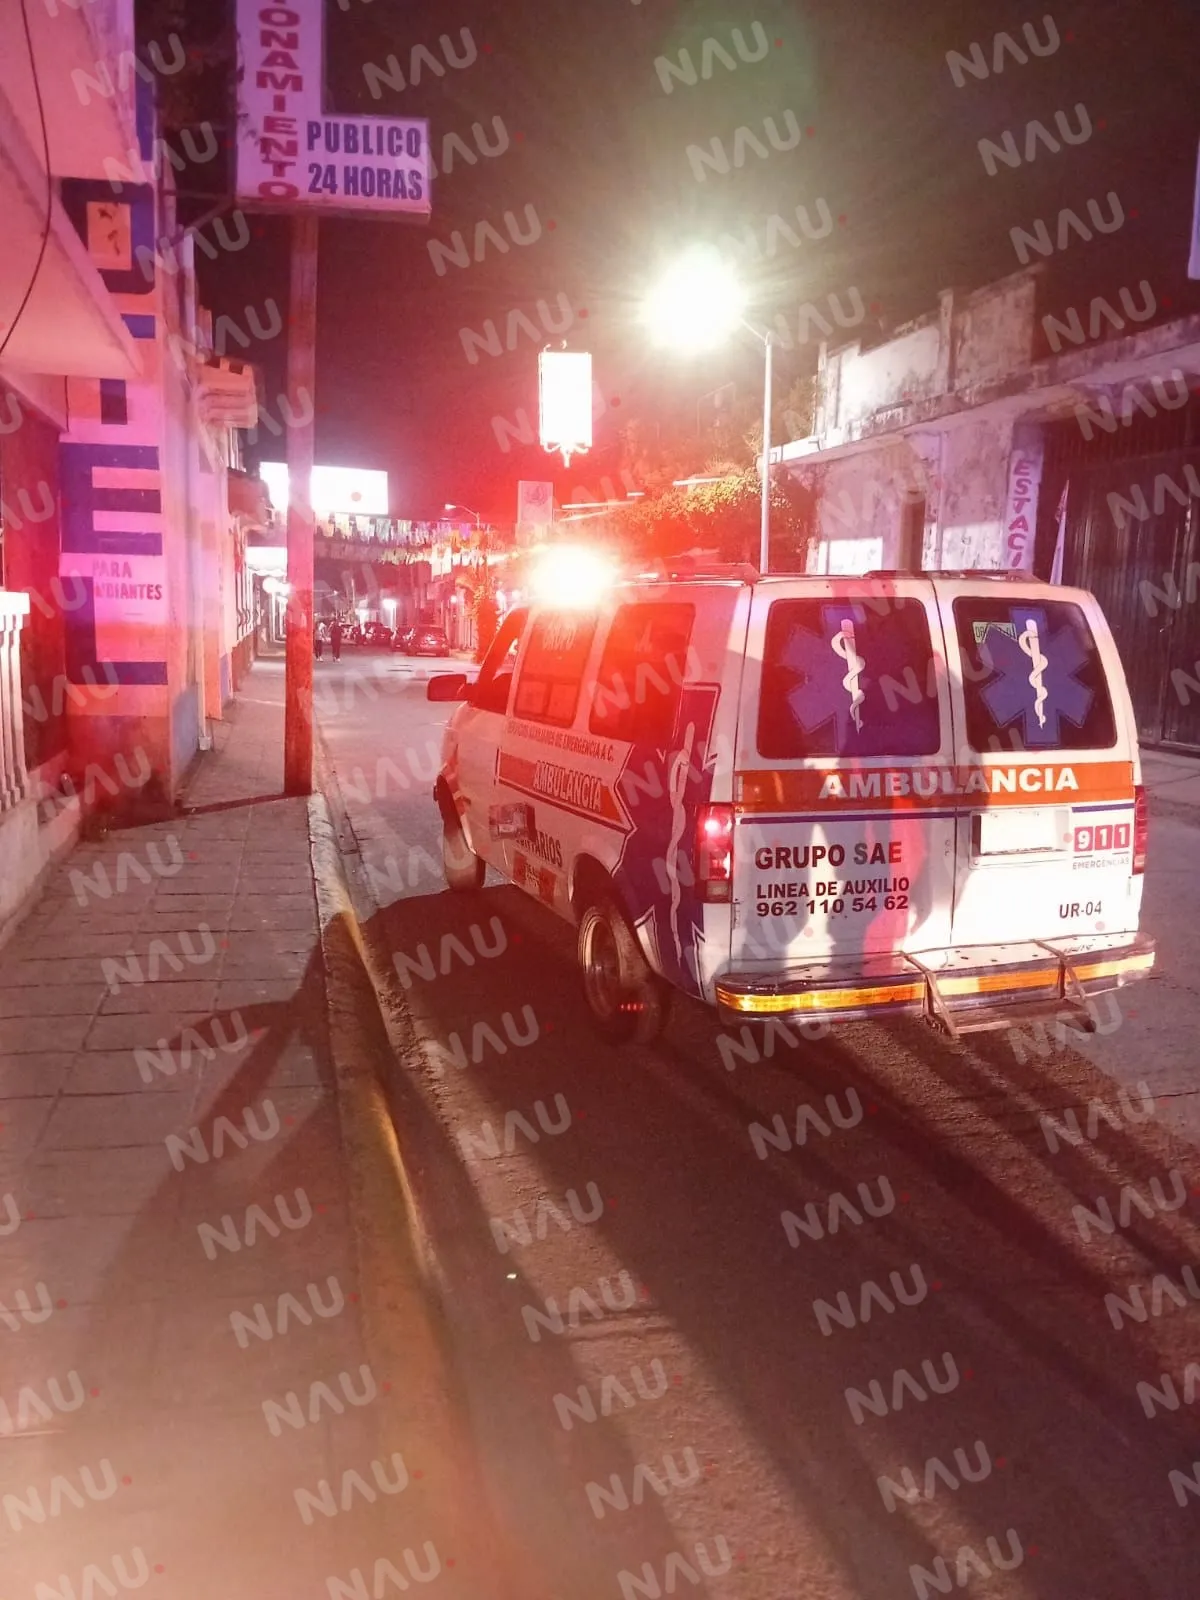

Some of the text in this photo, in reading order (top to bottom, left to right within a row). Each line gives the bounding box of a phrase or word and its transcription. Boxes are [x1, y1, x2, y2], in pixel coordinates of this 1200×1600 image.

[256, 0, 303, 200] ONAMIENTO
[307, 120, 422, 158] PUBLICO
[307, 163, 423, 200] 24 HORAS
[92, 560, 132, 579] PARA
[533, 760, 602, 811] AMBULANCIA
[818, 767, 1080, 799] AMBULANCIA
[1076, 826, 1127, 850] 911
[754, 841, 903, 870] GRUPO SAE
[1072, 857, 1130, 870] EMERGENCIAS
[756, 877, 910, 899] LINEA DE AUXILIO
[756, 895, 909, 917] 962 110 54 62
[1058, 900, 1103, 919] UR-04
